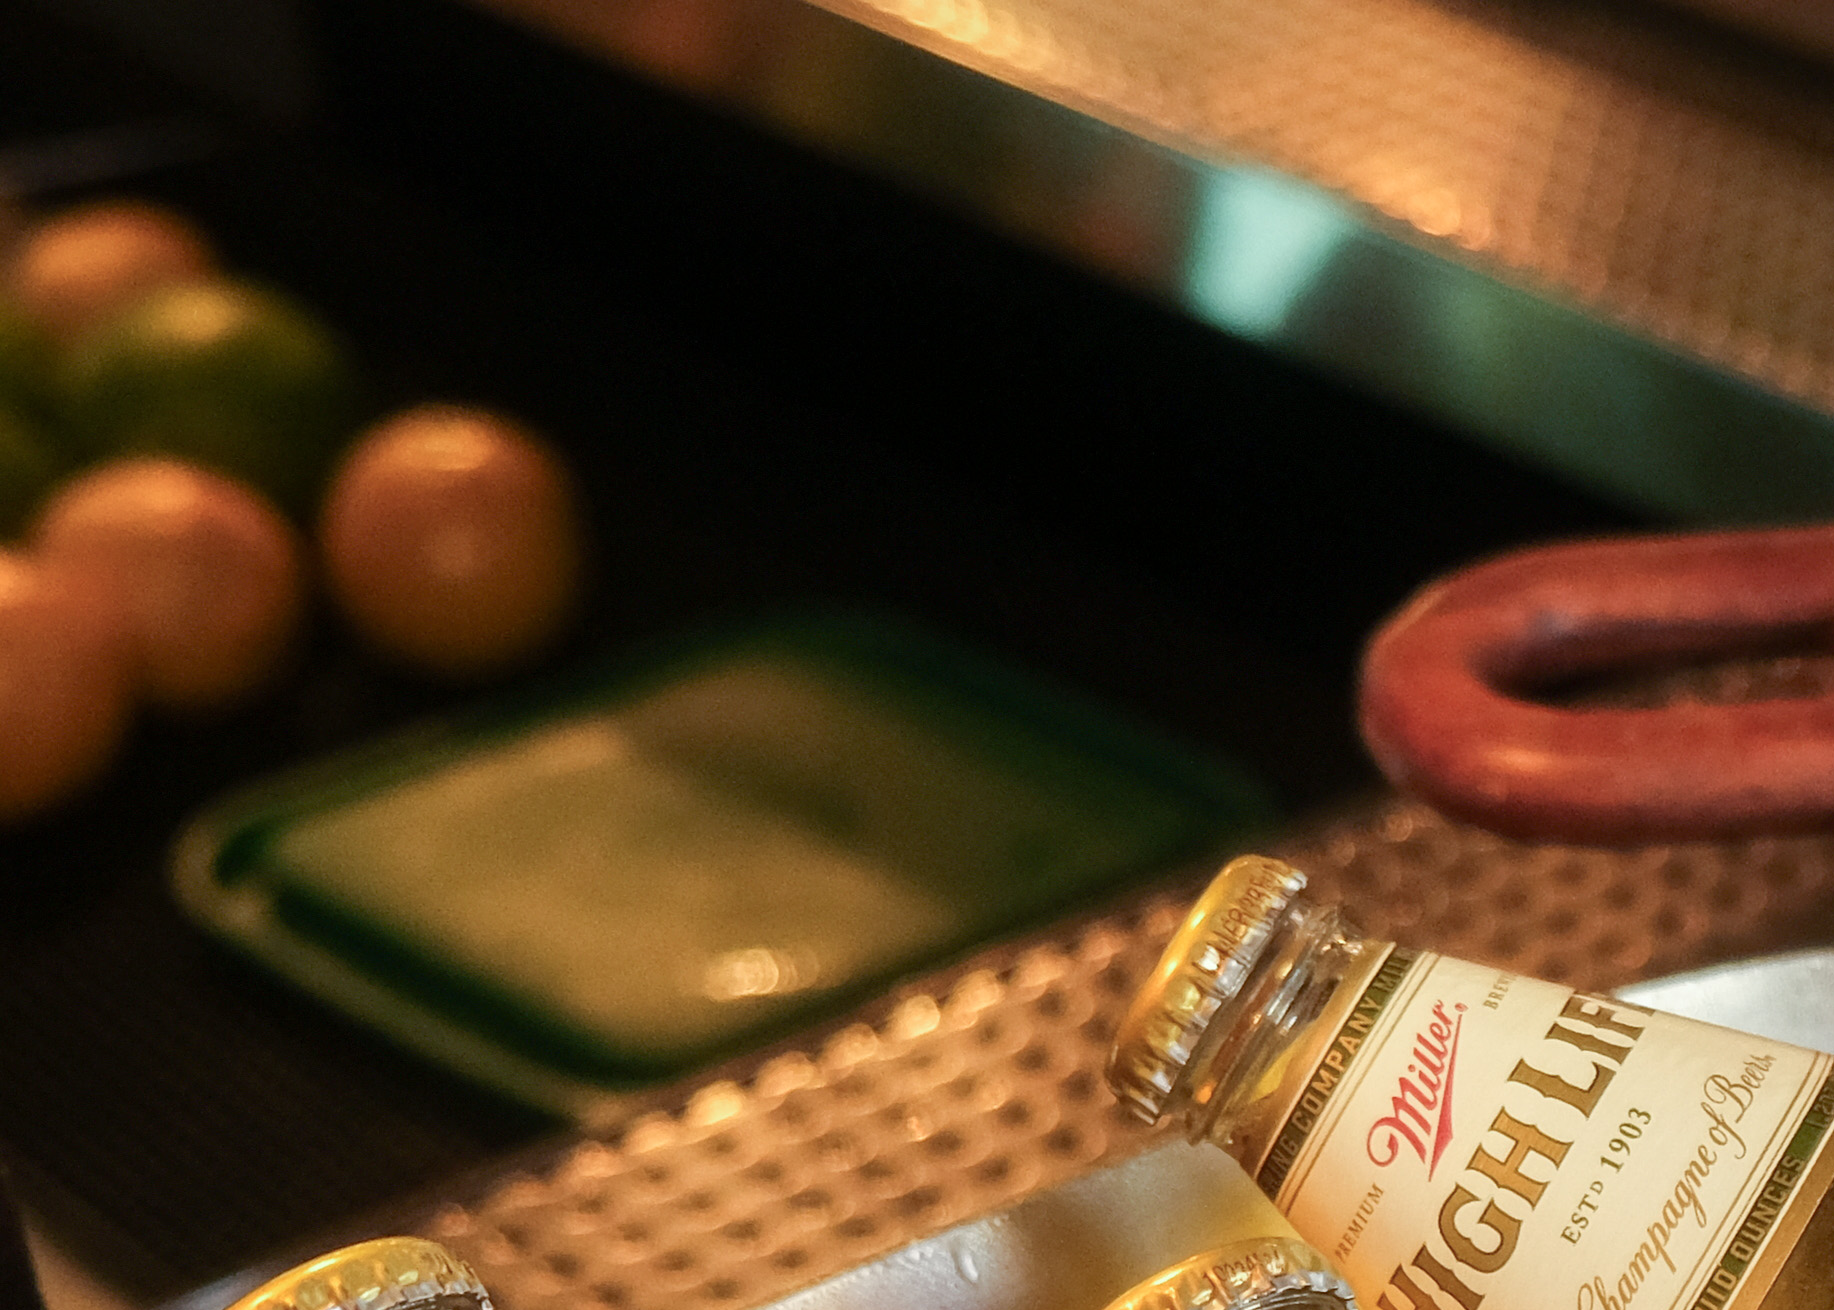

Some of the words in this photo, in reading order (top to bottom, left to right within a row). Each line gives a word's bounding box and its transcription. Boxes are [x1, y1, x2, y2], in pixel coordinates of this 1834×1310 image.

[1300, 992, 1384, 1131] COMPANY
[1366, 1000, 1461, 1168] Miller
[1599, 1107, 1652, 1173] 1903
[1701, 1100, 1746, 1160] of
[1335, 1183, 1384, 1262] PREMIUM
[1734, 1153, 1804, 1263] OUNCES
